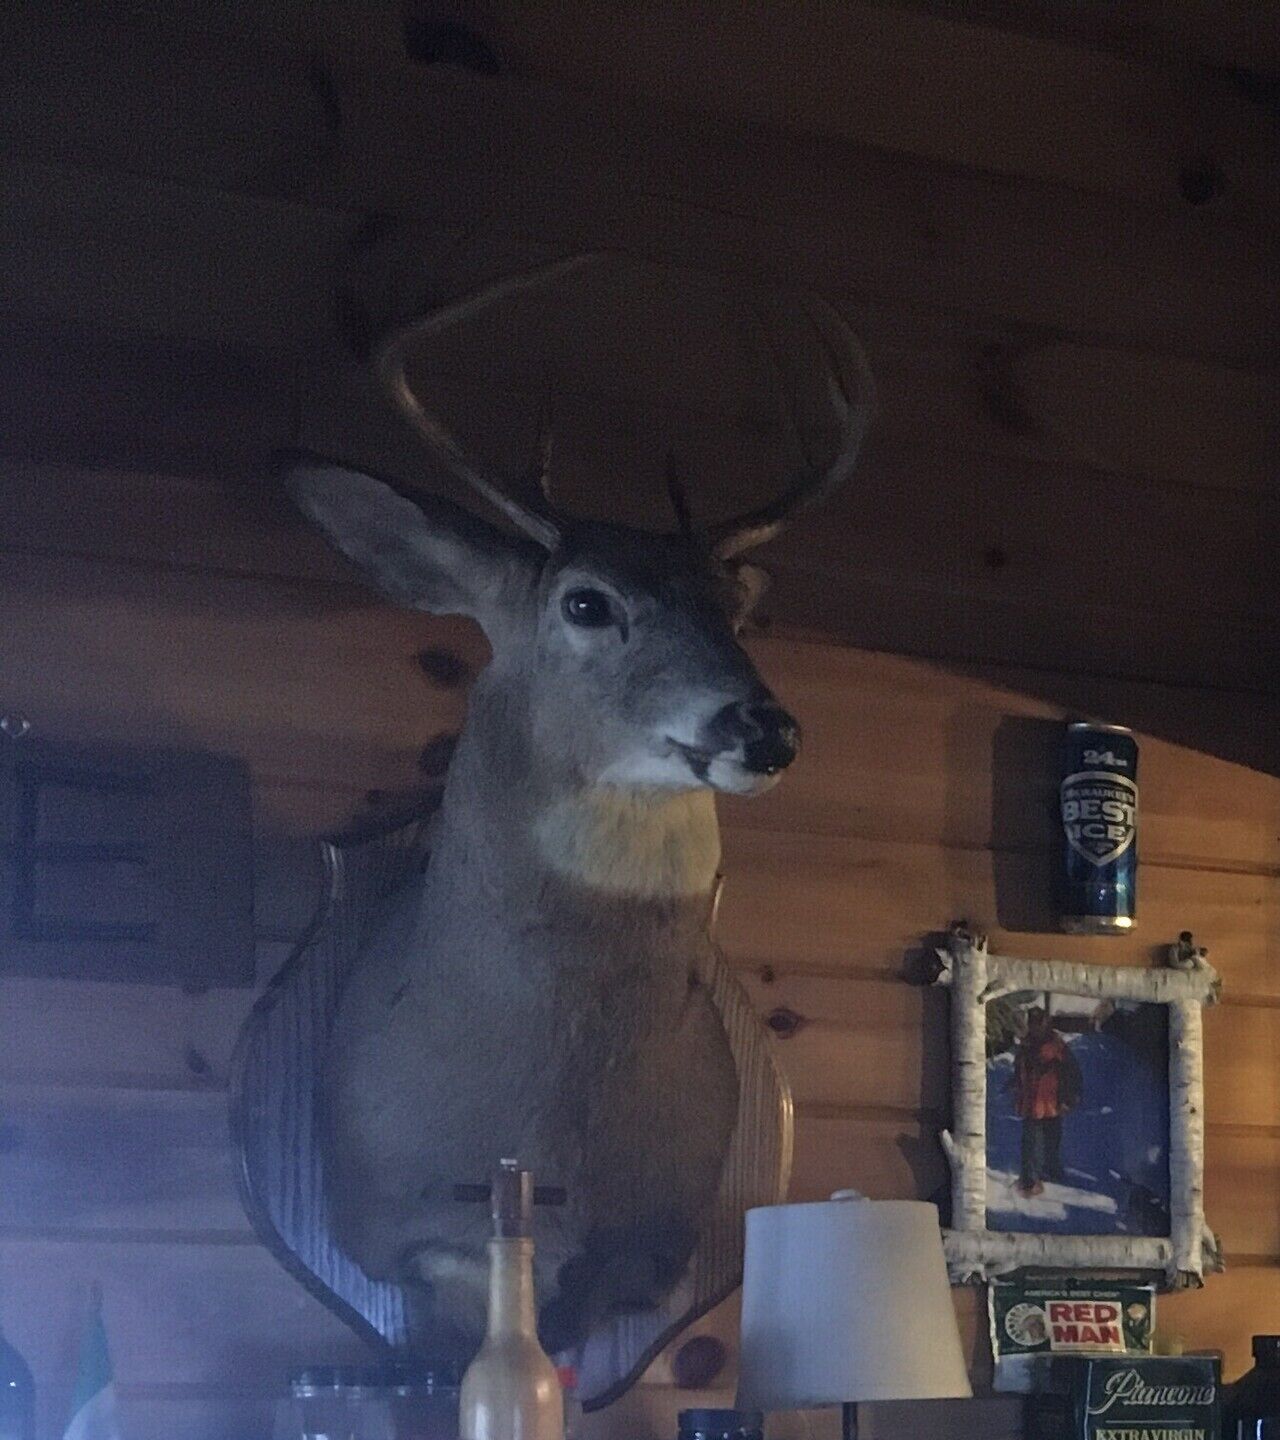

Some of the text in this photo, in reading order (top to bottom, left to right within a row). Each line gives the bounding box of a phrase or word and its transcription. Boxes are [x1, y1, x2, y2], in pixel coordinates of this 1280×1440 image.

[1063, 799, 1136, 825] BEST
[1071, 823, 1127, 842] ICE
[1049, 1303, 1119, 1324] RED
[1052, 1325, 1121, 1345] MAN
